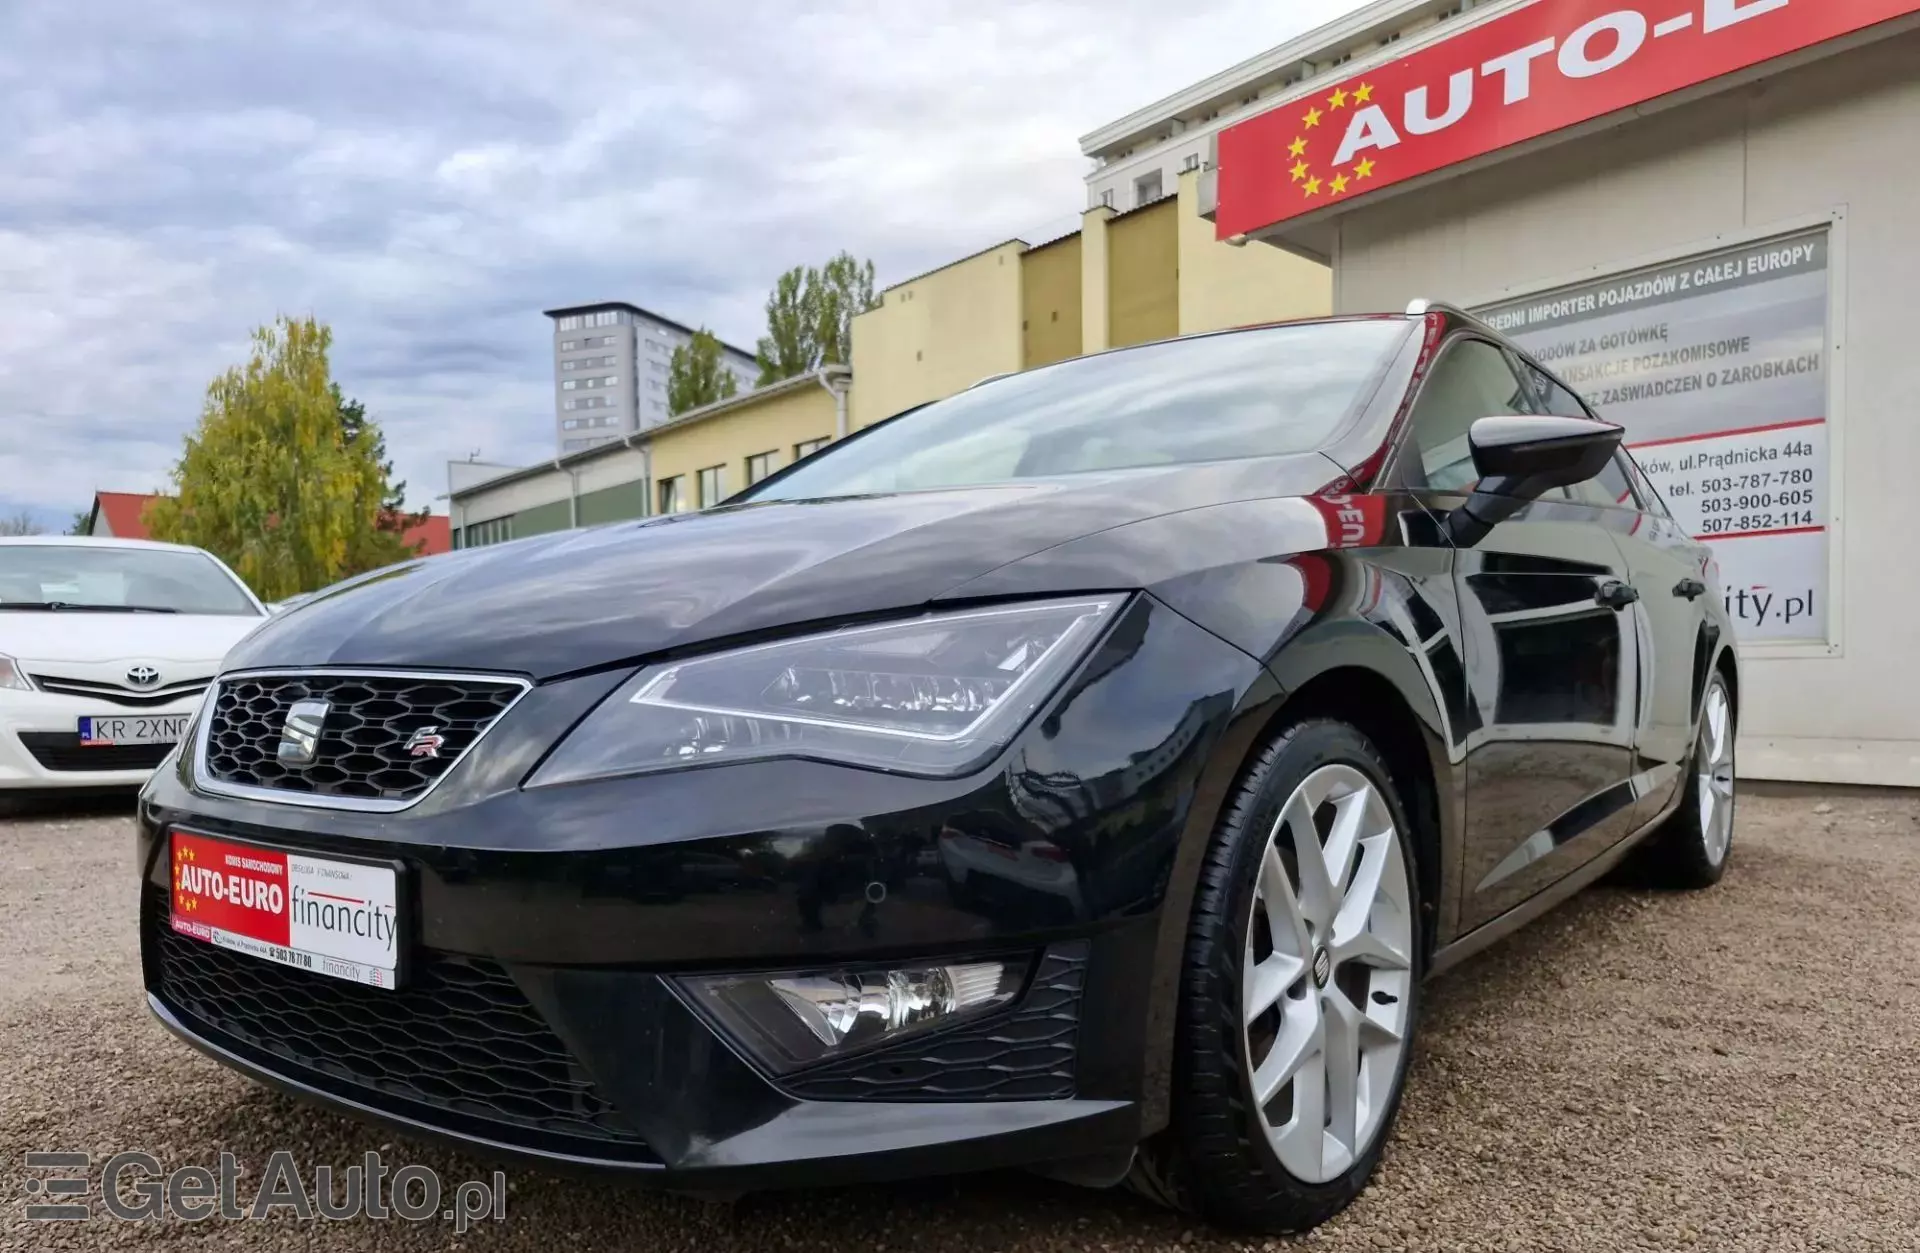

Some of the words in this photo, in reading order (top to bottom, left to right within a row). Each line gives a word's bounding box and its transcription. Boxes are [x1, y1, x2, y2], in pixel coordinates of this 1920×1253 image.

[1528, 294, 1596, 323] IMPORTER
[1598, 273, 1677, 308] POJAZDÓW
[1679, 274, 1690, 290] Z
[1693, 259, 1743, 286] CAŁEJ
[1746, 243, 1815, 275] EUROPY
[1578, 340, 1596, 354] ZA
[1599, 322, 1669, 350] GOTÓWKĘ
[1633, 336, 1750, 372] POZAKOMISOWE
[1706, 371, 1717, 388] O
[1721, 354, 1819, 386] ZAROBKACH
[1783, 441, 1813, 457] 44a
[1669, 480, 1695, 497] tel.
[1701, 468, 1813, 495] 503-787-780
[1701, 489, 1813, 513] 503-900-605
[1702, 510, 1813, 533] 507-852-114
[96, 720, 125, 738] KR
[180, 863, 283, 915] AUTO-EURO
[174, 919, 210, 939] AUTO-EURO
[291, 885, 397, 952] financity
